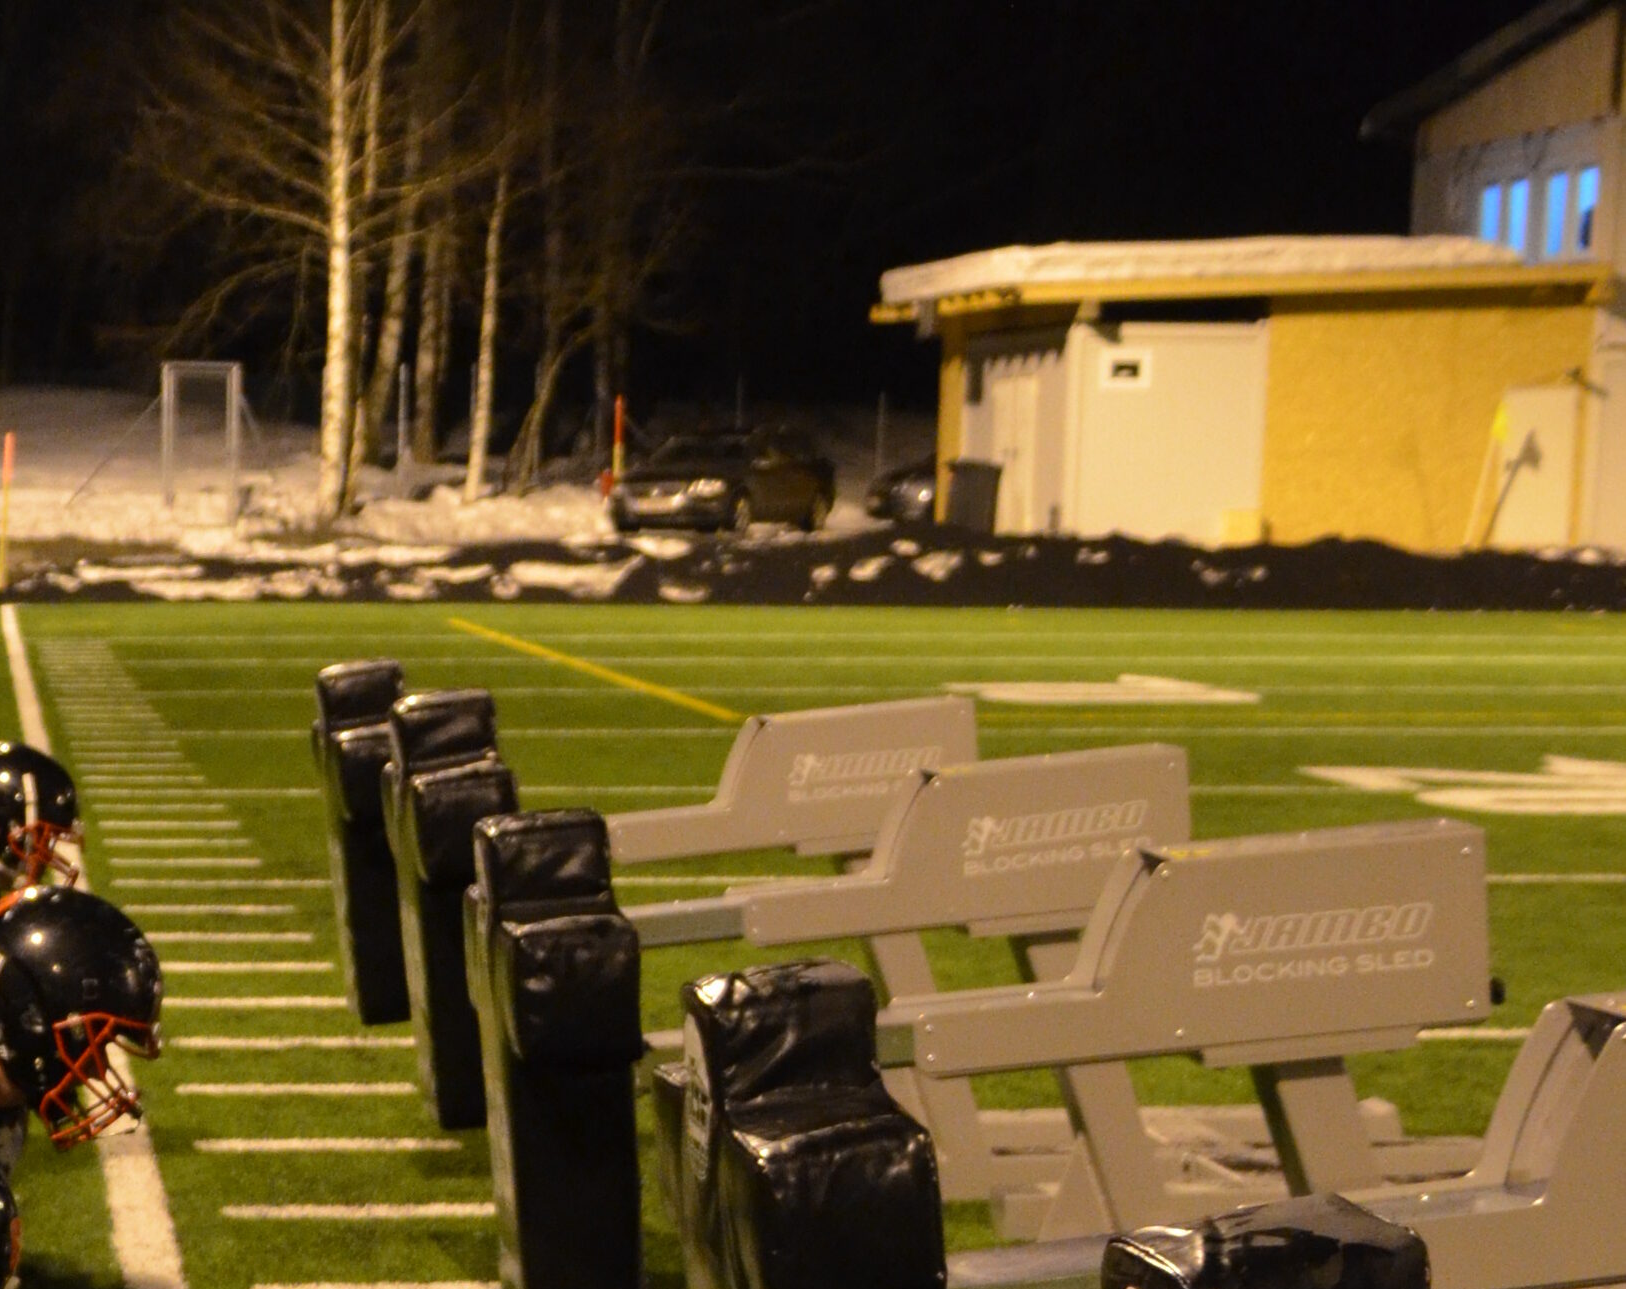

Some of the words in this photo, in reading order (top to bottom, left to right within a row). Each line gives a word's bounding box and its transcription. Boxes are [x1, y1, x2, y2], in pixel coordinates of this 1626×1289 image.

[964, 845, 1086, 876] BLOCKING
[1227, 902, 1433, 954] JAMBO
[1193, 955, 1350, 988] BLOCKING
[1355, 948, 1435, 975] SLED
